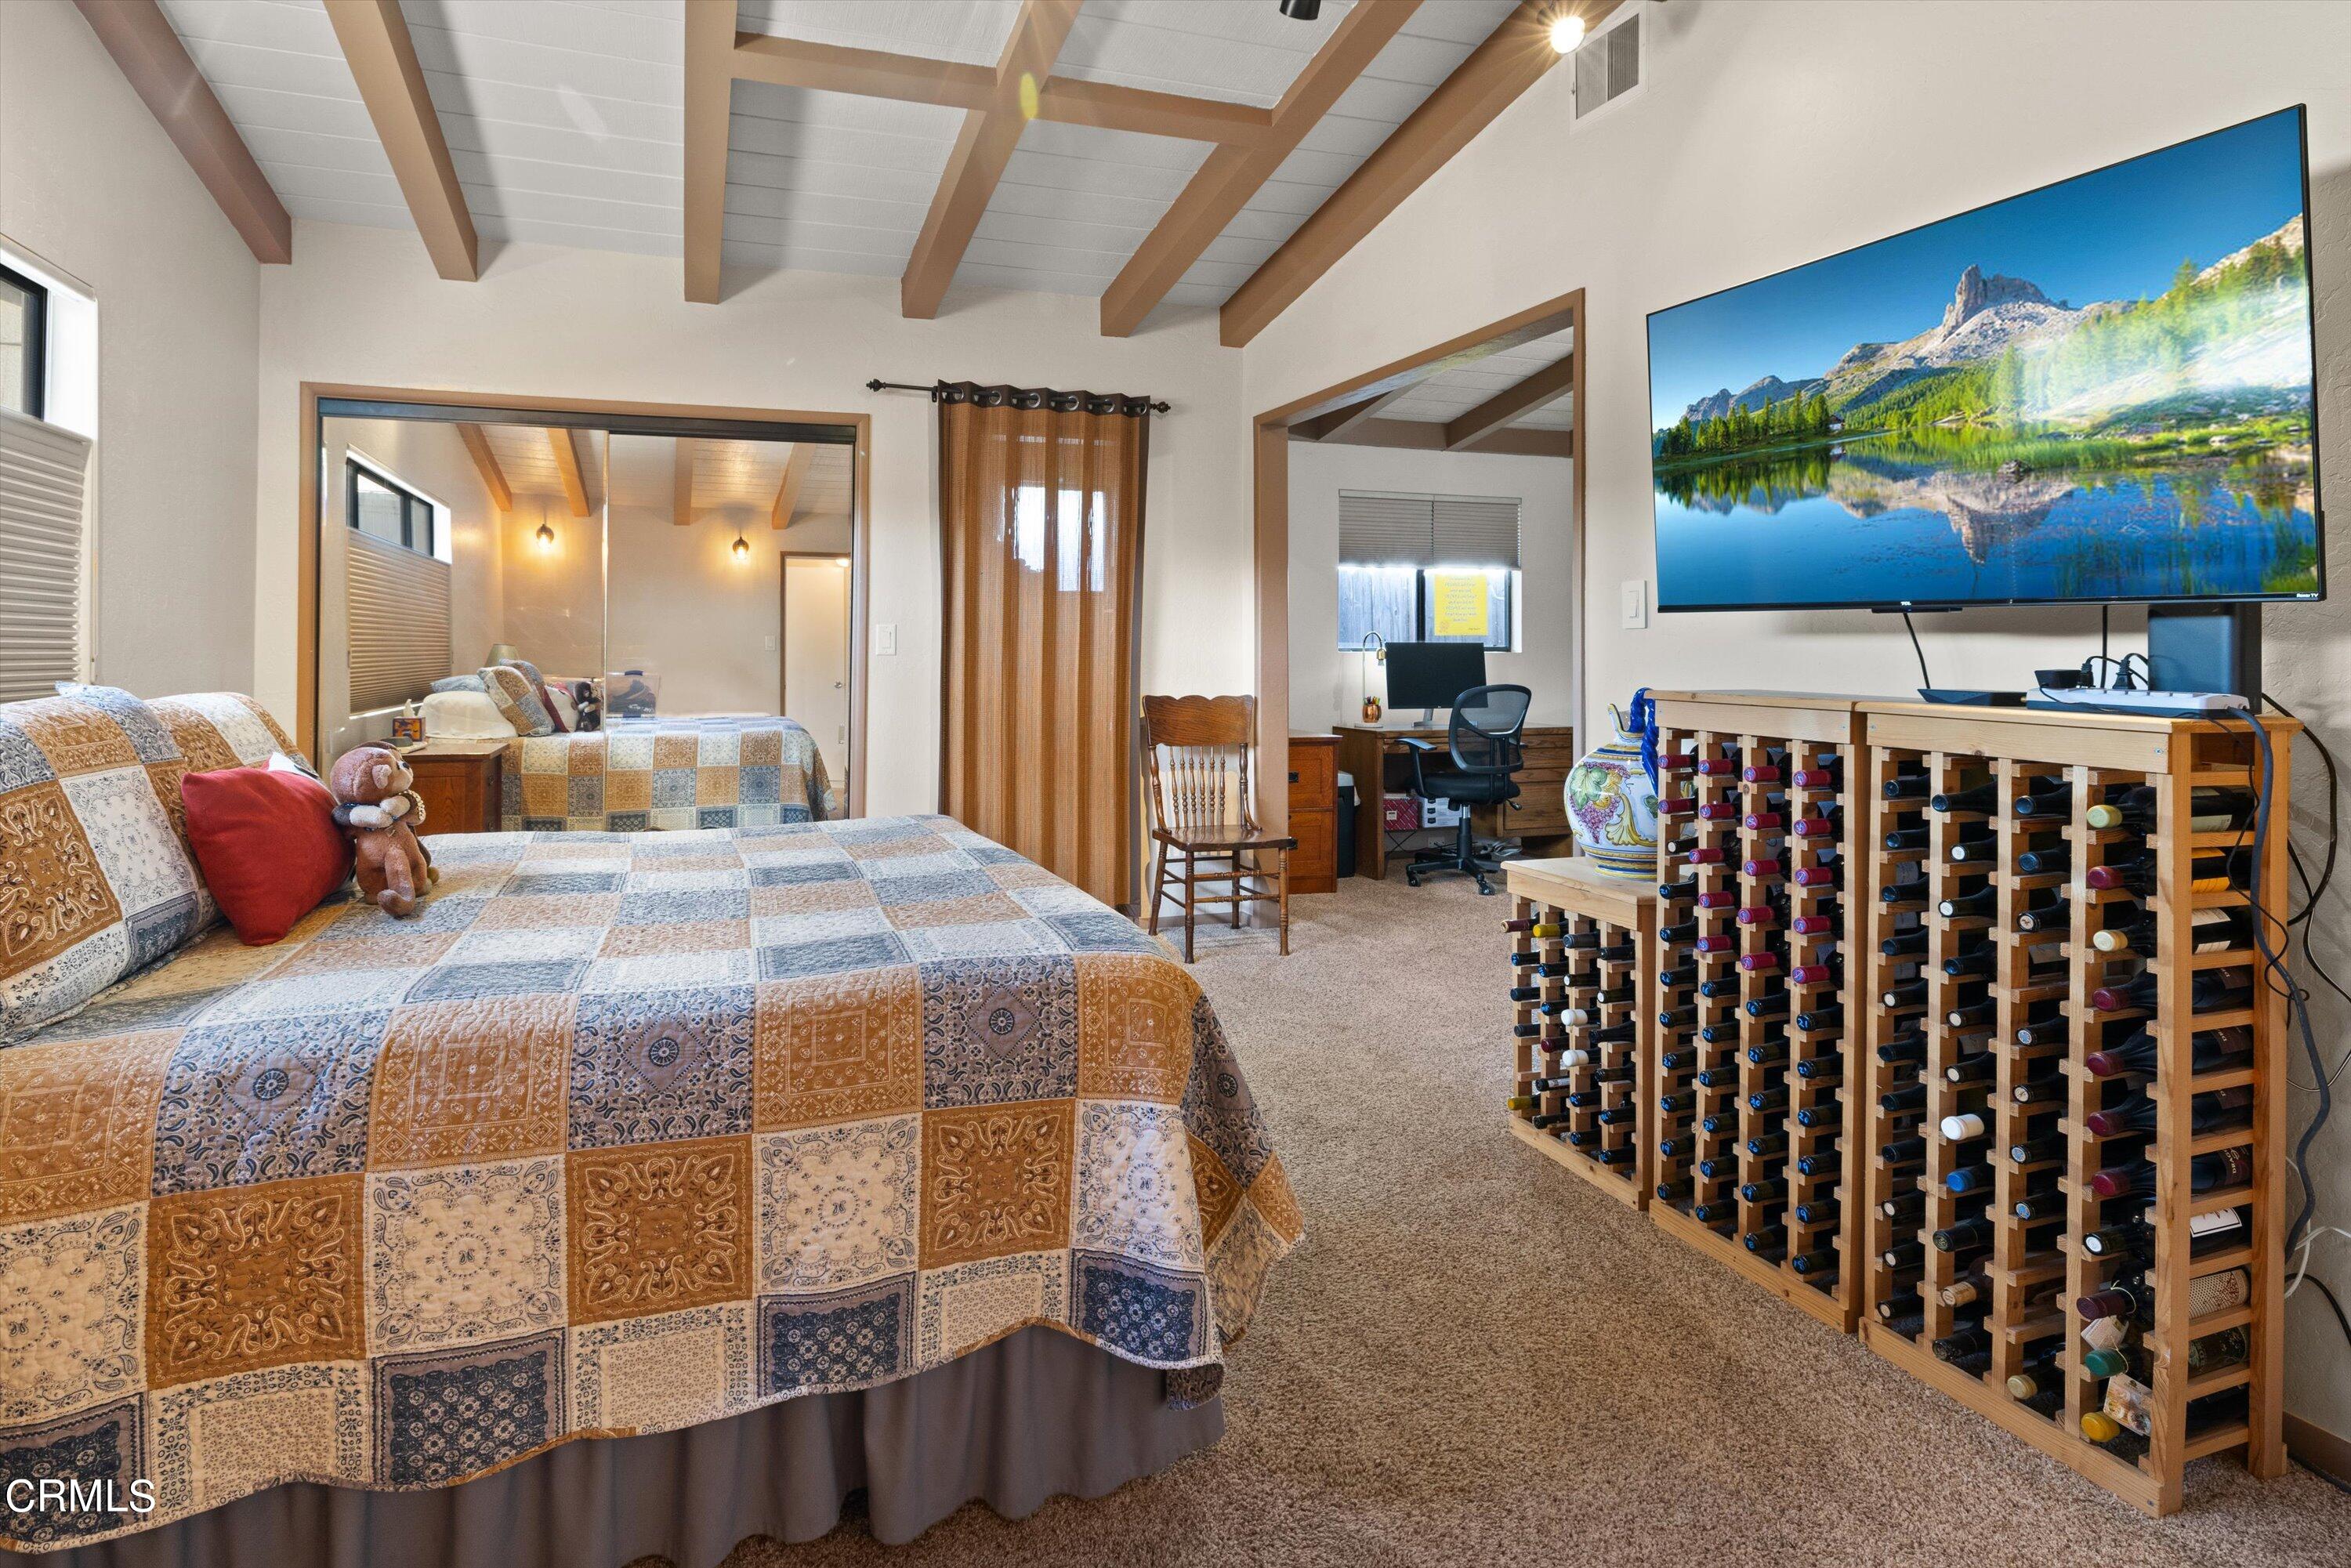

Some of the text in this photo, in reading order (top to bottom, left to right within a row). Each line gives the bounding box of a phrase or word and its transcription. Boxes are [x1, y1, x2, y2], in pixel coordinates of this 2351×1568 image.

[1798, 1018, 1808, 1028] 21
[1703, 1030, 1711, 1040] 21
[1749, 1050, 1758, 1061] 21
[1663, 1058, 1671, 1066] 21
[1700, 1075, 1708, 1085] 21
[1661, 1100, 1669, 1110] 20
[1799, 1112, 1809, 1124] 20
[1704, 1121, 1714, 1131] 20
[1661, 1144, 1670, 1155] 19
[1748, 1142, 1758, 1153] 20
[1799, 1161, 1809, 1174] 19
[1742, 1187, 1752, 1200] 19
[1796, 1209, 1807, 1221] 19
